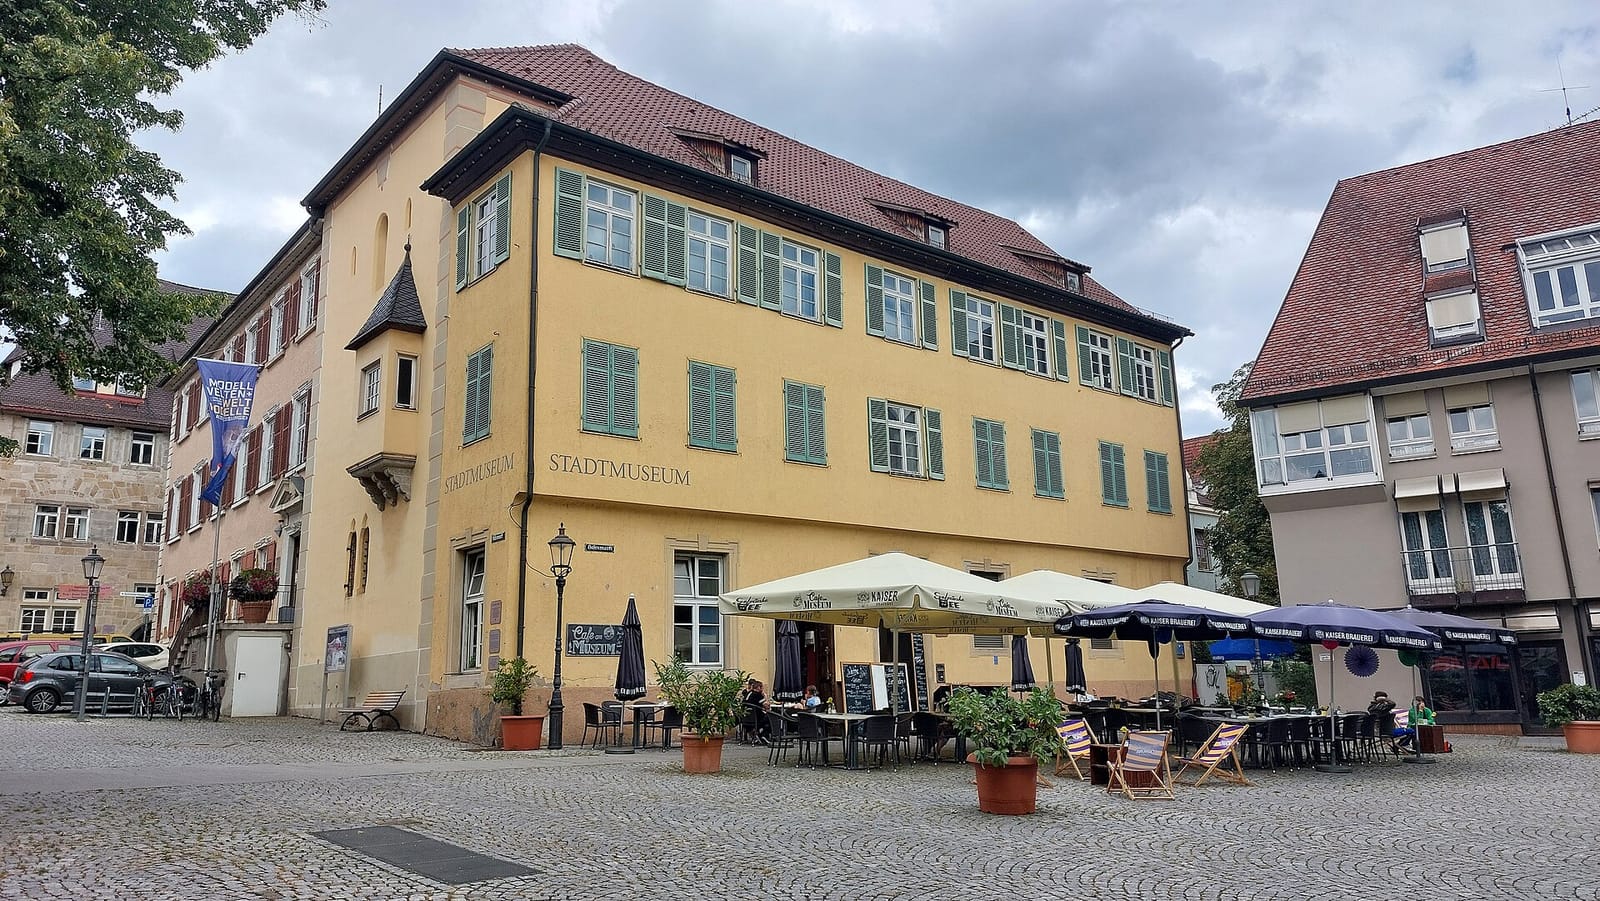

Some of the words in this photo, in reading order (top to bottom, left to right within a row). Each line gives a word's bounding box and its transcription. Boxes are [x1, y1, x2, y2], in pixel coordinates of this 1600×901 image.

[209, 378, 253, 390] MODELL
[444, 452, 515, 494] STADTMUSEUM
[549, 453, 691, 485] STADTMUSEUM
[871, 590, 898, 602] KAISER
[803, 600, 831, 610] MUSEUM
[1151, 617, 1170, 625] KAISER
[1170, 618, 1196, 627] BRAUEREI
[1325, 631, 1345, 639] KAISER
[1345, 632, 1374, 642] BRAUEREI
[572, 640, 616, 654] MUSEUM
